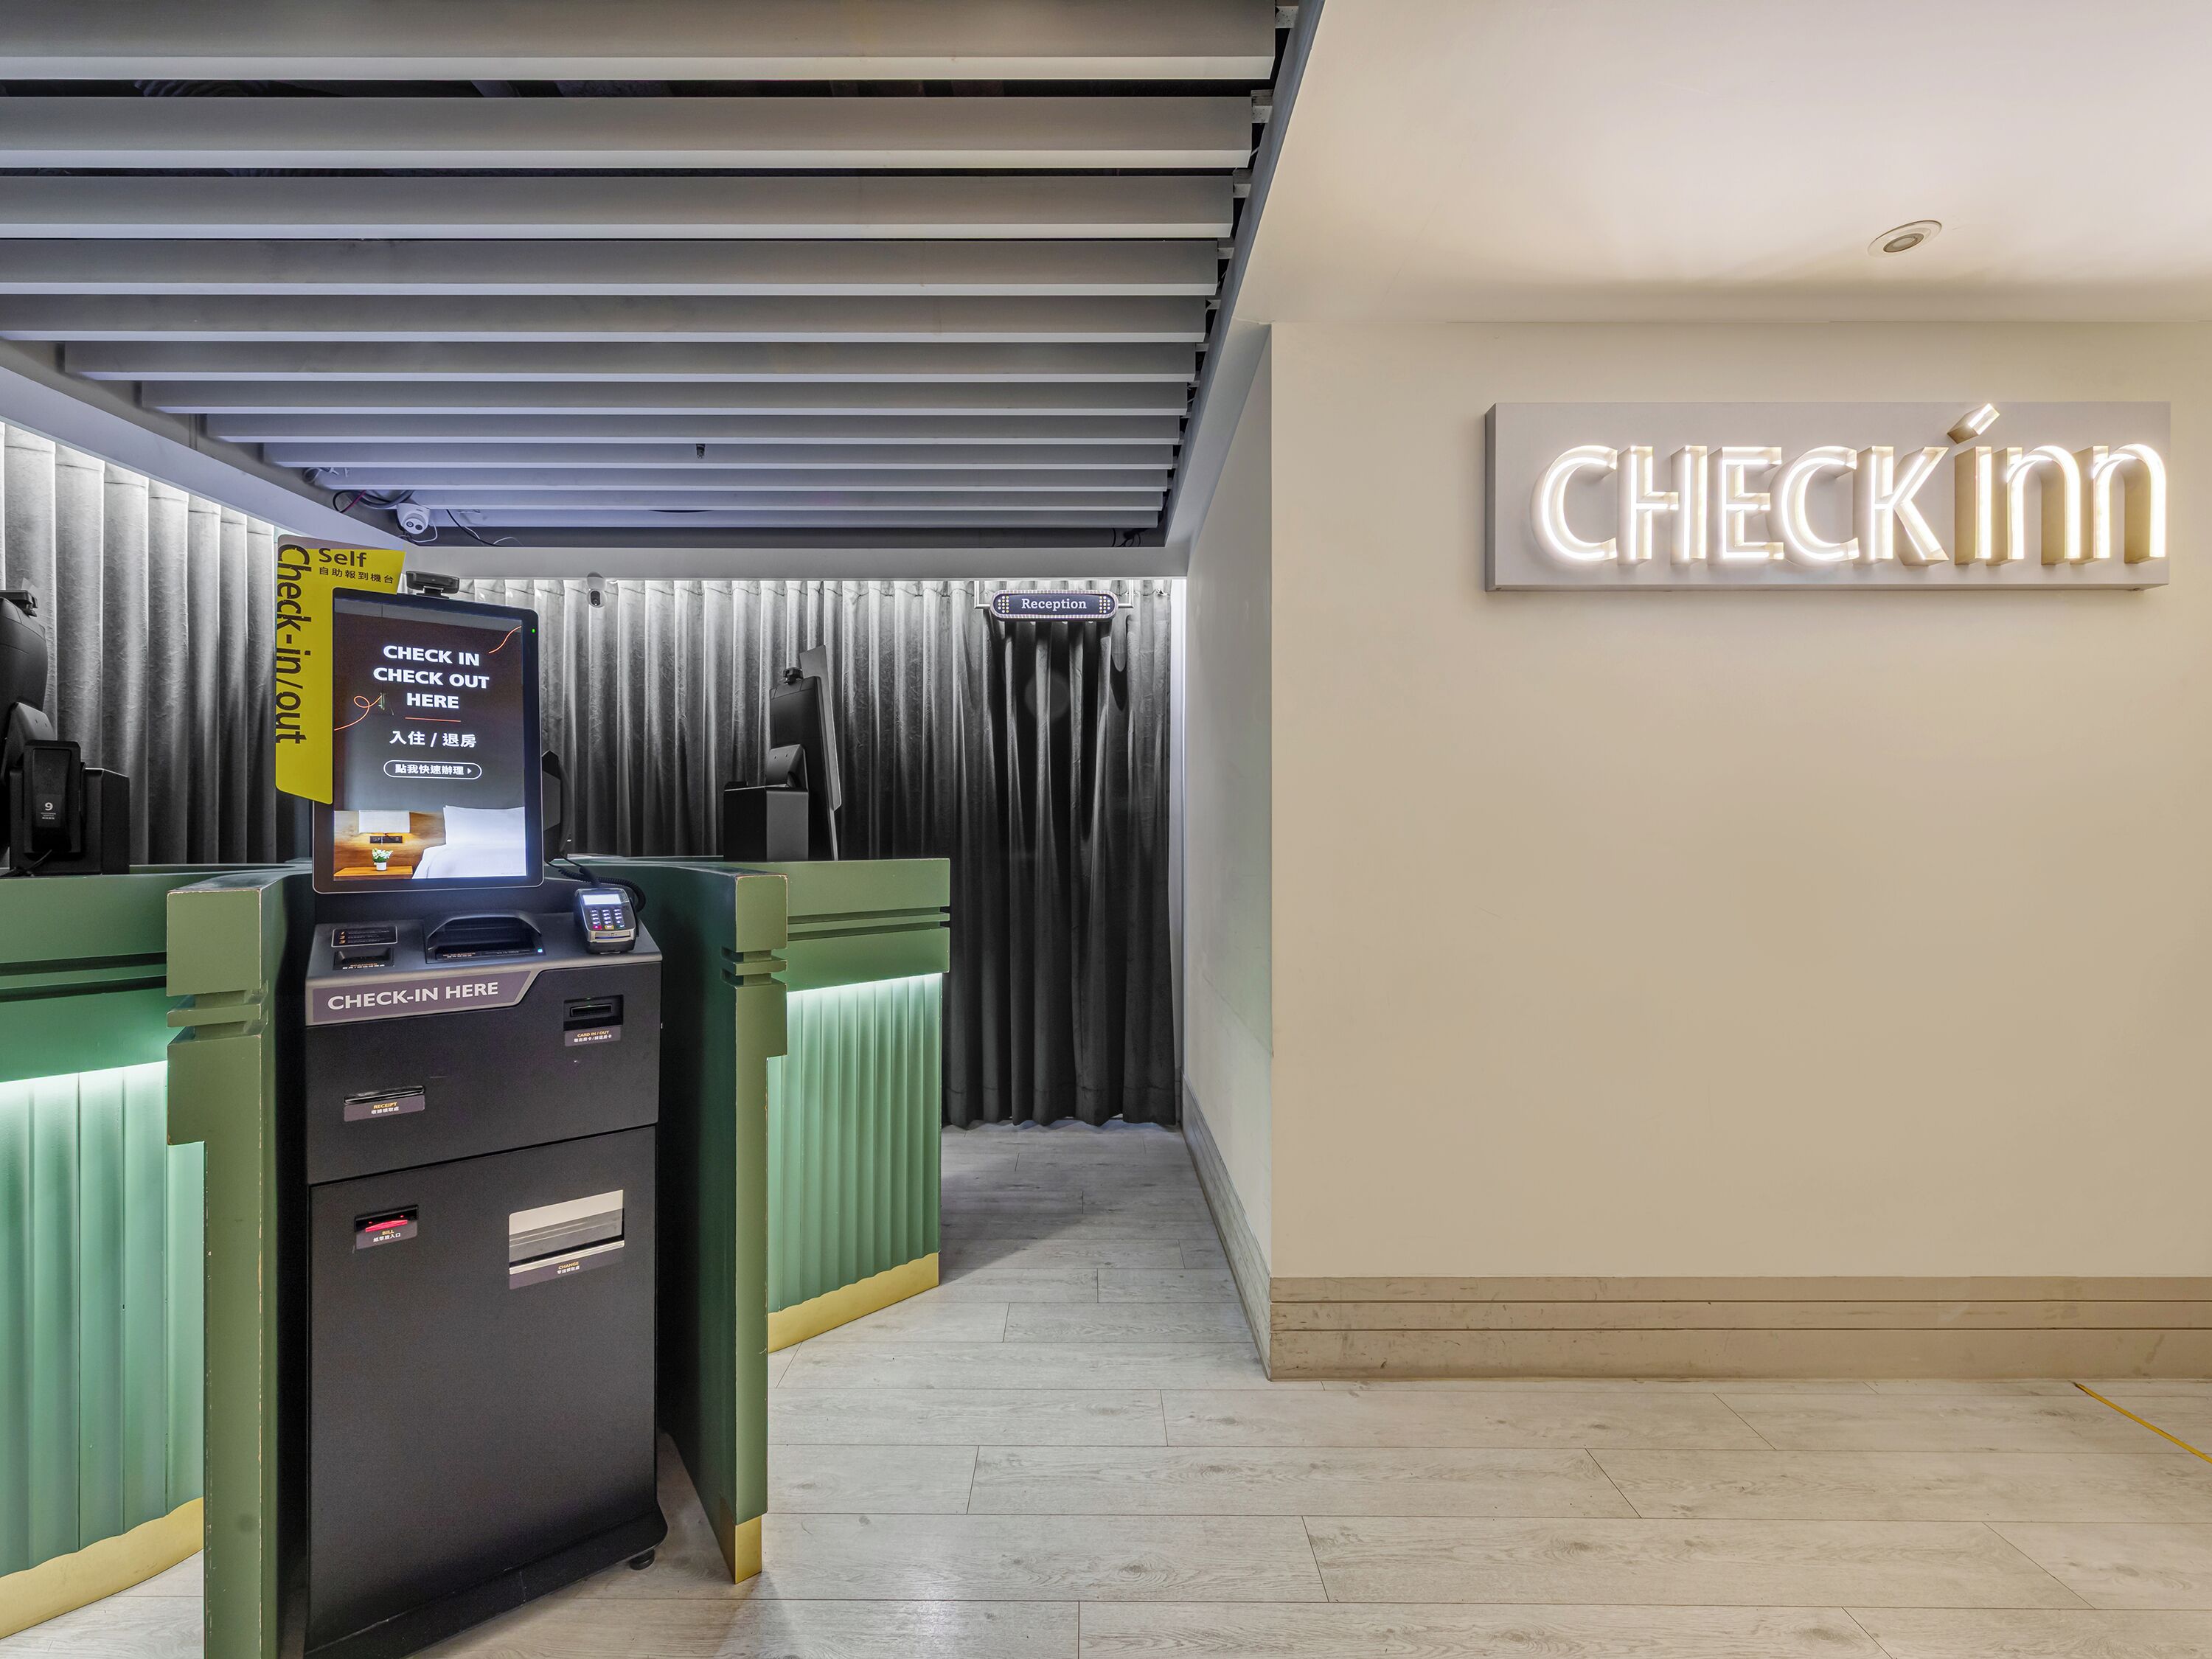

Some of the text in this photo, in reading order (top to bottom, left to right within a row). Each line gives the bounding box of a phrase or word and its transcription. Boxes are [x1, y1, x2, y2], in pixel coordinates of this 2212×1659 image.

[319, 547, 367, 567] Self
[319, 566, 394, 584] 自助報到機台
[1021, 598, 1087, 611] Reception
[275, 544, 313, 745] Check-in/out
[383, 645, 479, 667] CHECK IN
[373, 667, 490, 689] CHECK OUT
[406, 692, 459, 709] HERE
[389, 731, 425, 745] 入住
[442, 733, 476, 748] 退房
[394, 764, 465, 775] 點我快速辦理
[44, 802, 53, 811] 9
[327, 982, 498, 1010] CHECK-IN HERE
